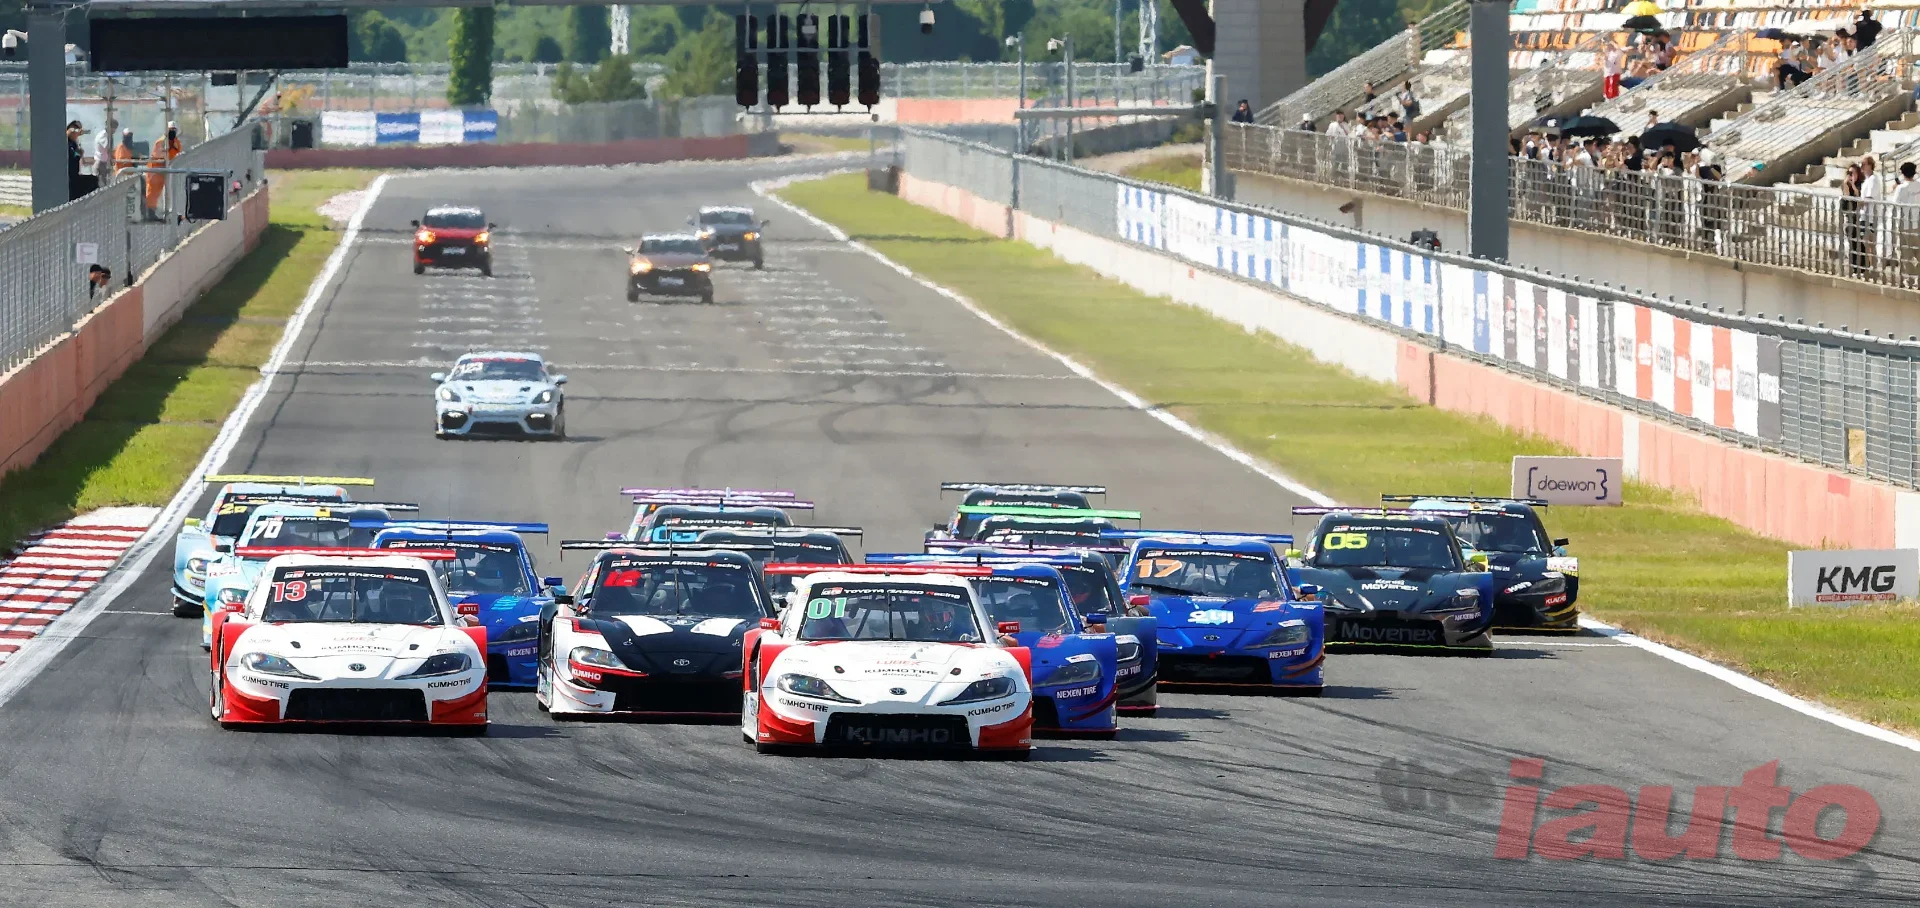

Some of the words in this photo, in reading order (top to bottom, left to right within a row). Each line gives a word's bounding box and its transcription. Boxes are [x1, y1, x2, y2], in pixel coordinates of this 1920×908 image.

[1538, 474, 1596, 492] daewon
[251, 520, 283, 540] 70
[481, 544, 512, 552] Racing
[1323, 532, 1368, 550] 05
[1234, 553, 1264, 561] Racing
[708, 562, 741, 570] Racing
[1136, 558, 1183, 578] 17
[385, 573, 420, 583] Racing
[1016, 577, 1049, 586] Racing
[1816, 565, 1896, 593] KMG
[272, 581, 308, 603] 13
[926, 590, 961, 600] Racing
[807, 597, 847, 620] 01
[507, 648, 532, 657] NEXEN
[1269, 650, 1292, 660] NEXEN
[571, 667, 602, 681] KUMHO
[241, 674, 268, 687] KUMHO
[268, 680, 290, 690] TIRE
[427, 681, 459, 689] KUMHO
[1056, 689, 1082, 699] NEXEN
[1082, 685, 1097, 696] TIRE
[779, 697, 806, 710] KUMHO
[806, 704, 829, 713] TIRE
[967, 705, 1001, 717] KUMHO
[1002, 701, 1016, 712] TIRE
[846, 726, 949, 744] KUMHO
